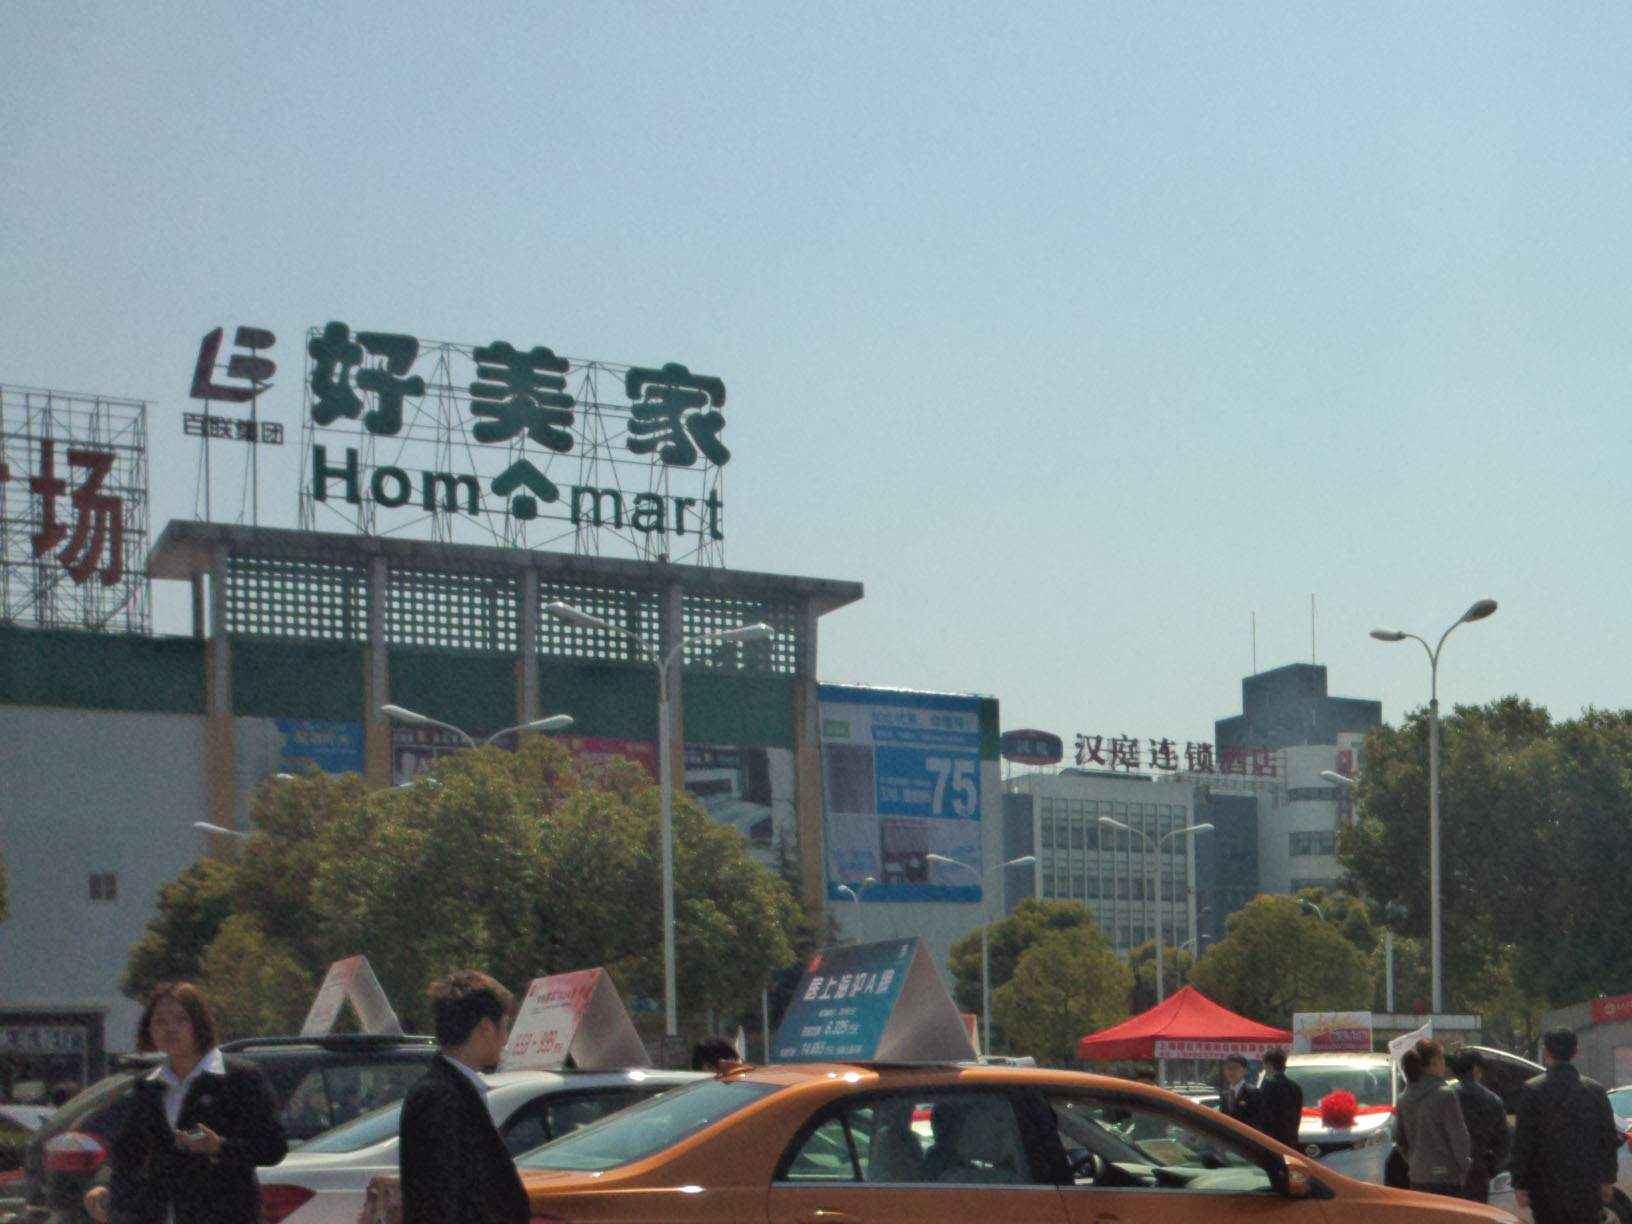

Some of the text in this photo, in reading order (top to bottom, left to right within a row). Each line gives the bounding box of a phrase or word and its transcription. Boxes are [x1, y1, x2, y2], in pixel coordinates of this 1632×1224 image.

[309, 321, 731, 467] 好美家
[182, 412, 284, 445] 百联集团
[0, 438, 123, 586] 场
[1074, 732, 1278, 778] 汉庭连锁酒店
[925, 757, 977, 818] 75
